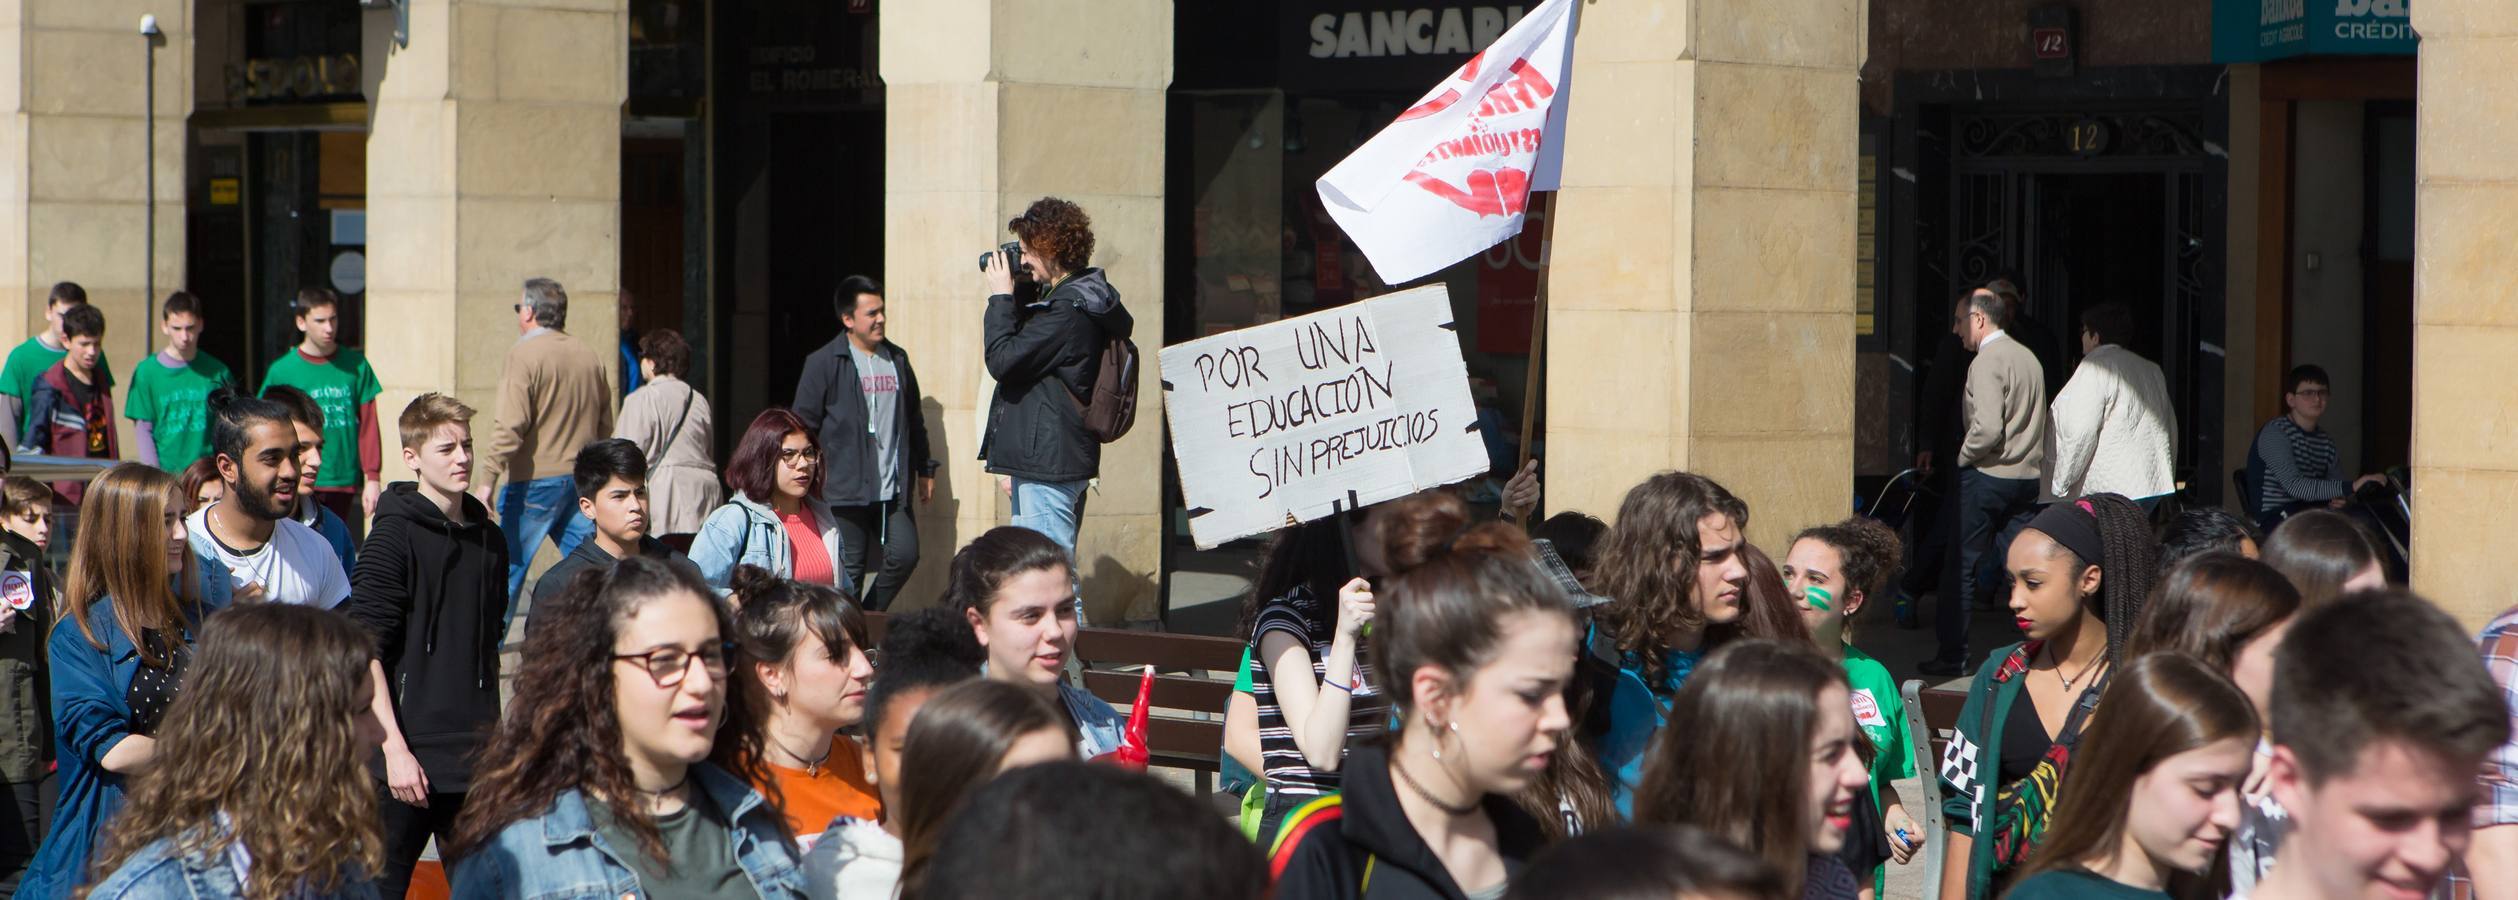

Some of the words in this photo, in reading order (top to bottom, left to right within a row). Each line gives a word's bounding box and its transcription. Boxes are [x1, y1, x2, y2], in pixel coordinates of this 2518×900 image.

[2042, 34, 2062, 52] 12
[750, 70, 775, 93] EL
[2072, 124, 2098, 152] 12
[1195, 346, 1268, 392] POR
[1295, 316, 1376, 370] UNA
[1250, 442, 1303, 499] SIN
[1311, 408, 1439, 475] PREJUICIOS
